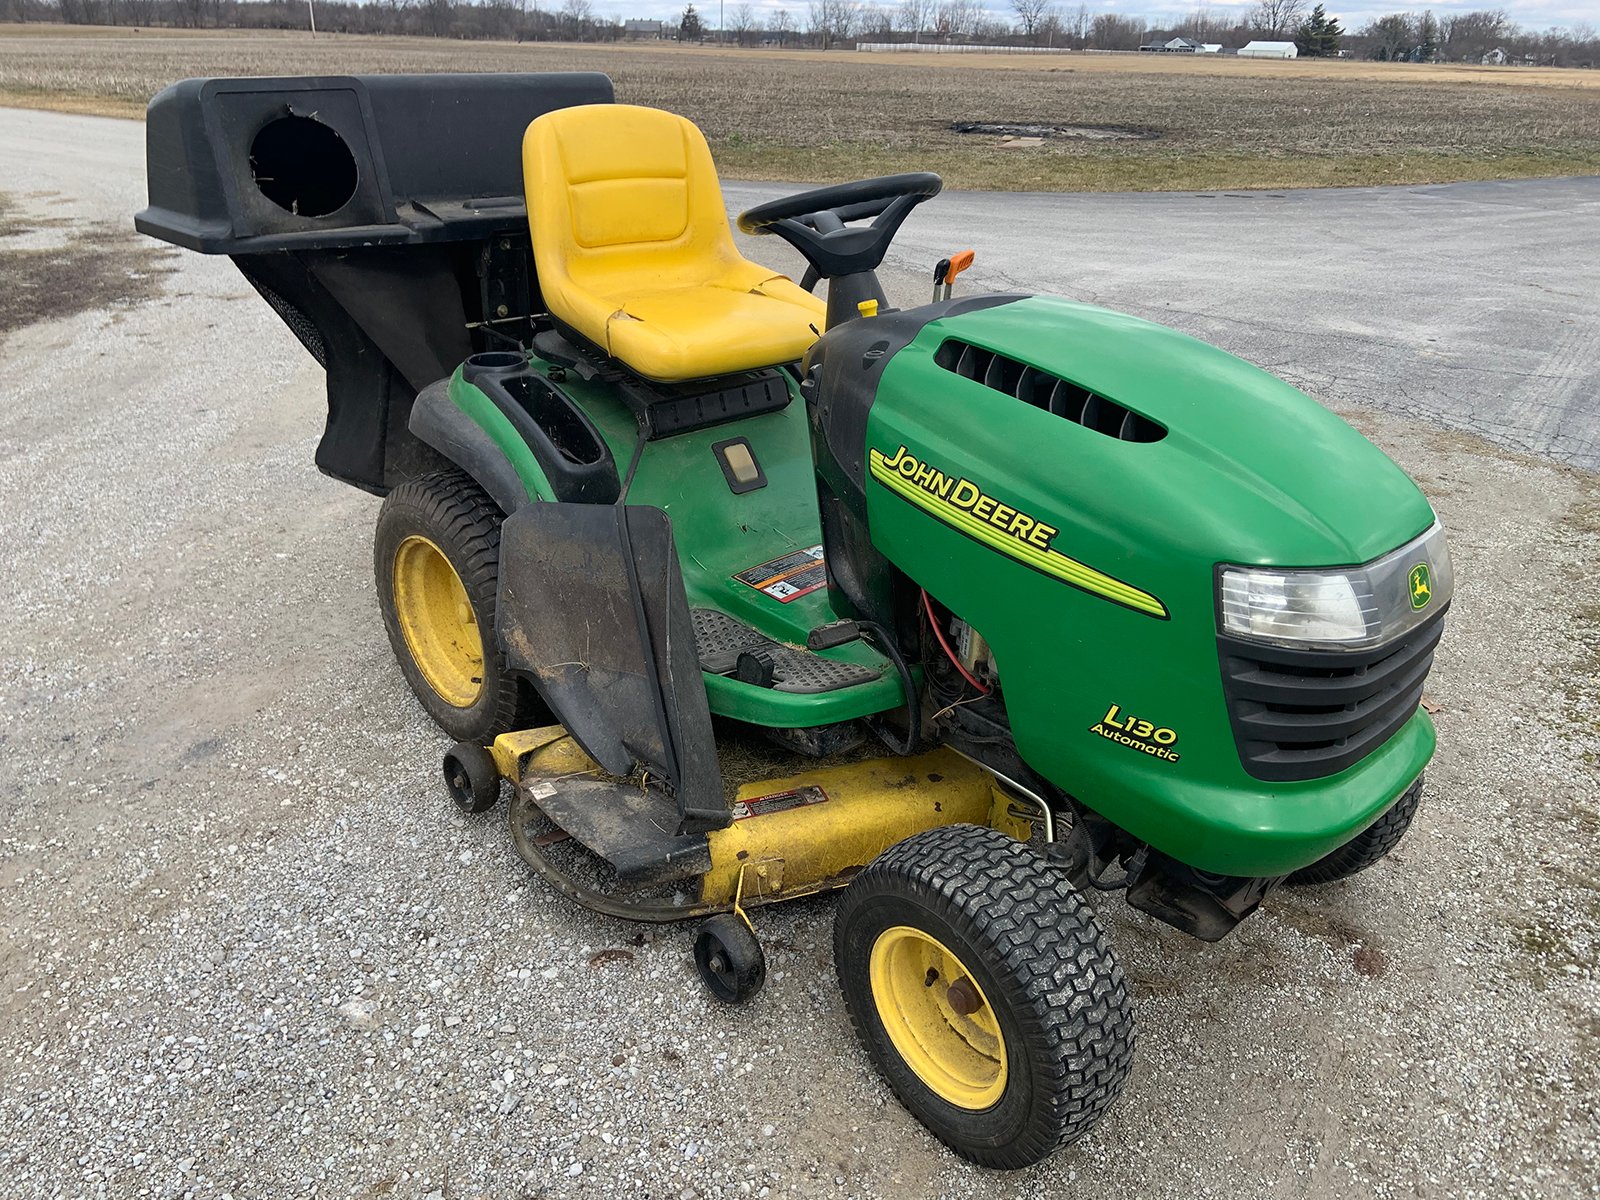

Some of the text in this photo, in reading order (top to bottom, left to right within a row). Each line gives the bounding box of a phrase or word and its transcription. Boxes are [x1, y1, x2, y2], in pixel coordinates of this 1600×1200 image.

[883, 446, 1056, 548] JOHN DEERE
[1090, 723, 1179, 762] Automatic
[1103, 704, 1177, 745] L130
